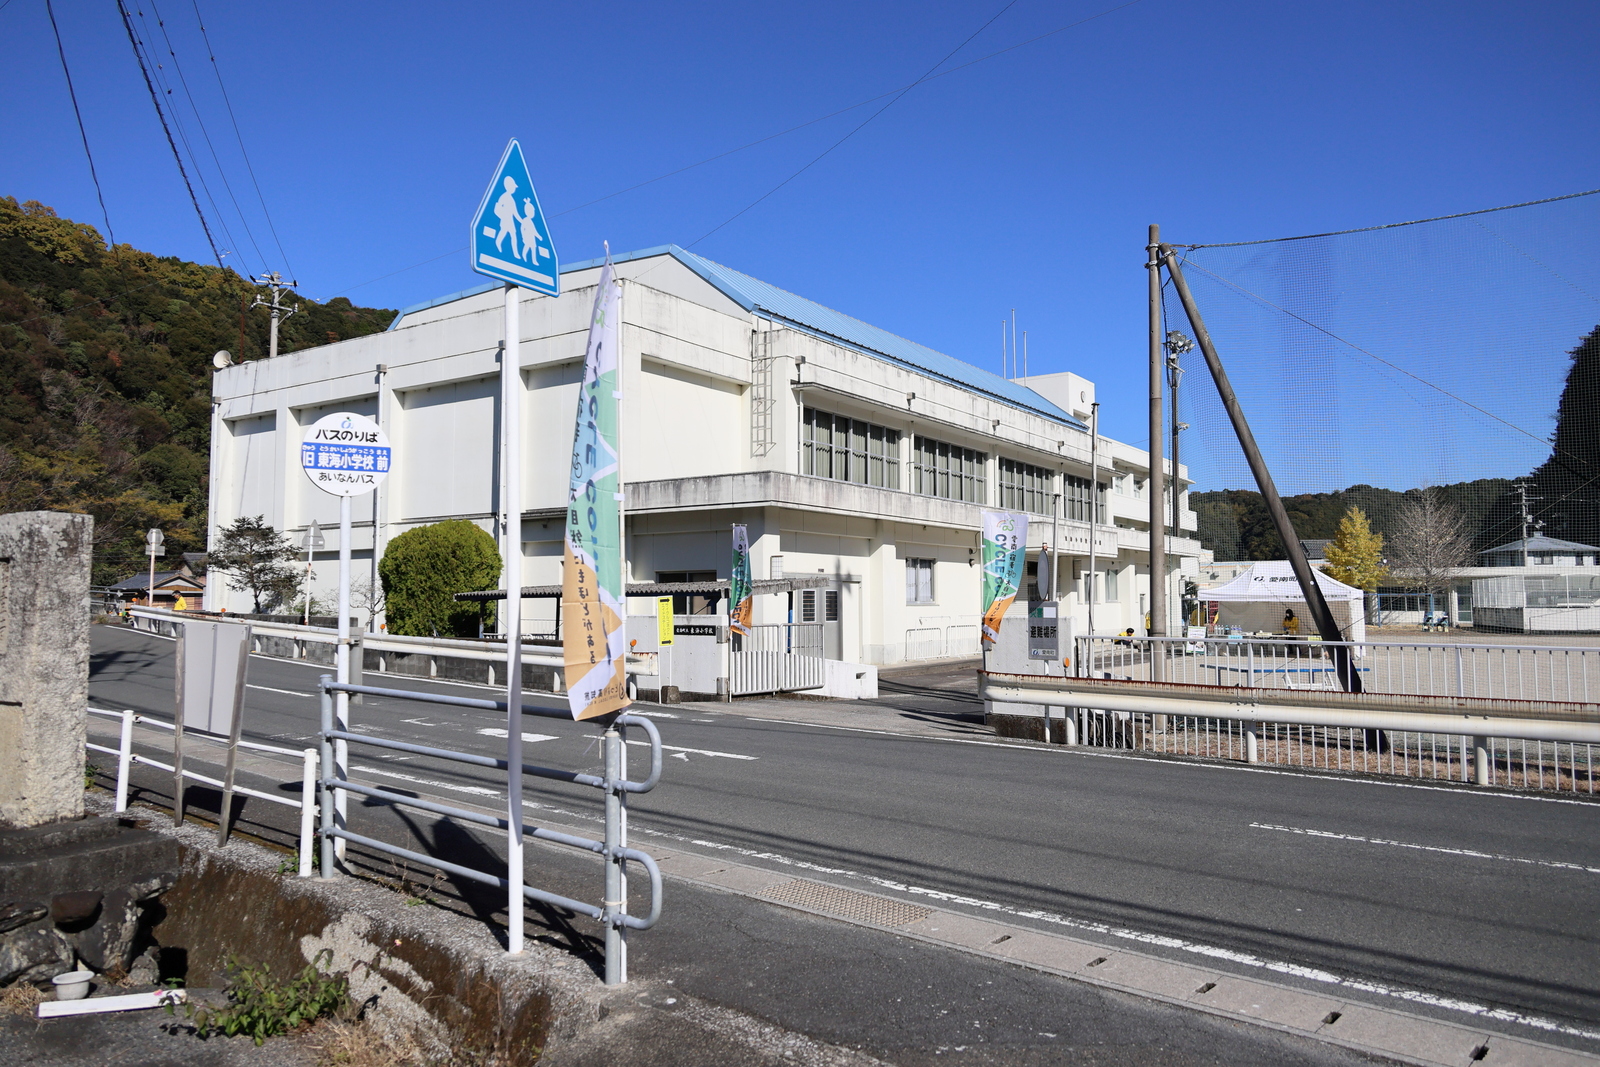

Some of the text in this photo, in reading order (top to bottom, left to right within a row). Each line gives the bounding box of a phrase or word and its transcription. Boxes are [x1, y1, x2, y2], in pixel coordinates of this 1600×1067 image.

[315, 429, 379, 443] バスのりば
[318, 472, 375, 484] あいなんバス
[995, 534, 1007, 574] CYCLE
[1030, 625, 1057, 639] 避難場所
